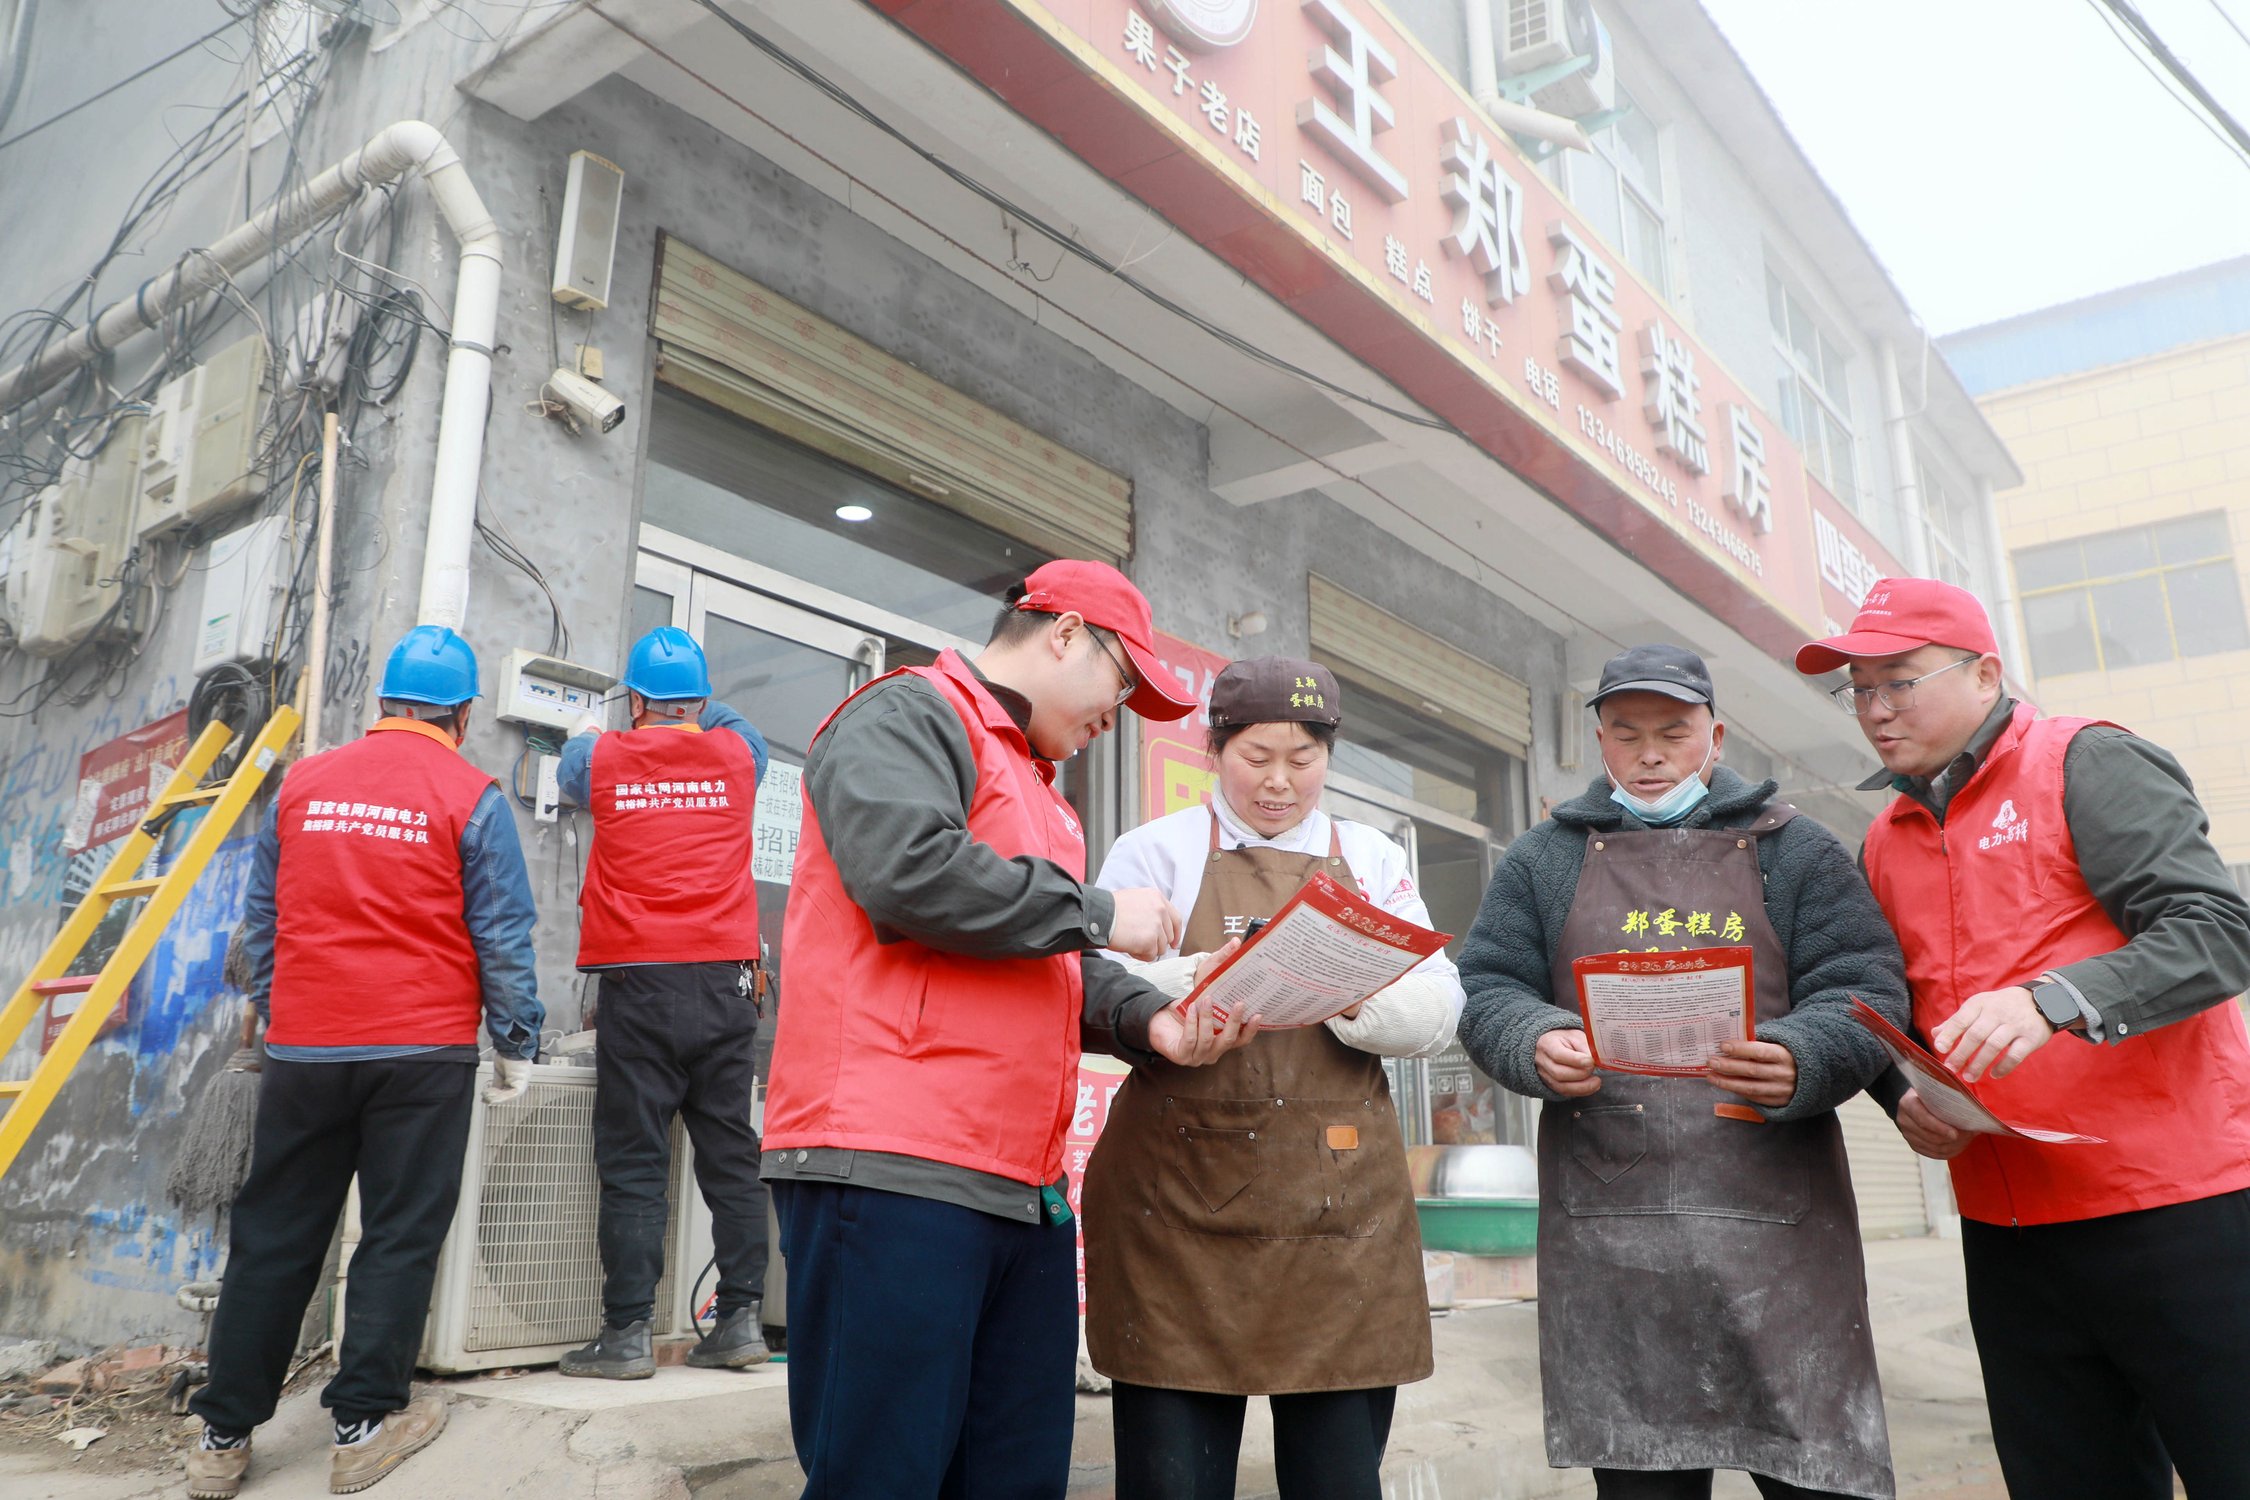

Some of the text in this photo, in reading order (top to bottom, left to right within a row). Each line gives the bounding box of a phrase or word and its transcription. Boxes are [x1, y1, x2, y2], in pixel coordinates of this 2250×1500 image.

[1123, 8, 1261, 162] 果子老店
[1299, 159, 1353, 240] 面包
[1384, 233, 1433, 304] 糕点
[1461, 296, 1502, 358] 饼干
[1525, 356, 1560, 411] 电话
[1577, 404, 1678, 507] 13346855245
[1299, 0, 1773, 535] 王郑蛋糕房
[1290, 692, 1324, 709] 蛋糕房
[615, 780, 726, 796] 国家电网河南电力
[306, 800, 429, 827] 国家电网河南电力
[615, 797, 729, 811] 焦裕禄共产党员服务队
[301, 818, 430, 845] 焦裕禄共产党员服务队
[1621, 907, 1746, 943] 郑蛋糕房
